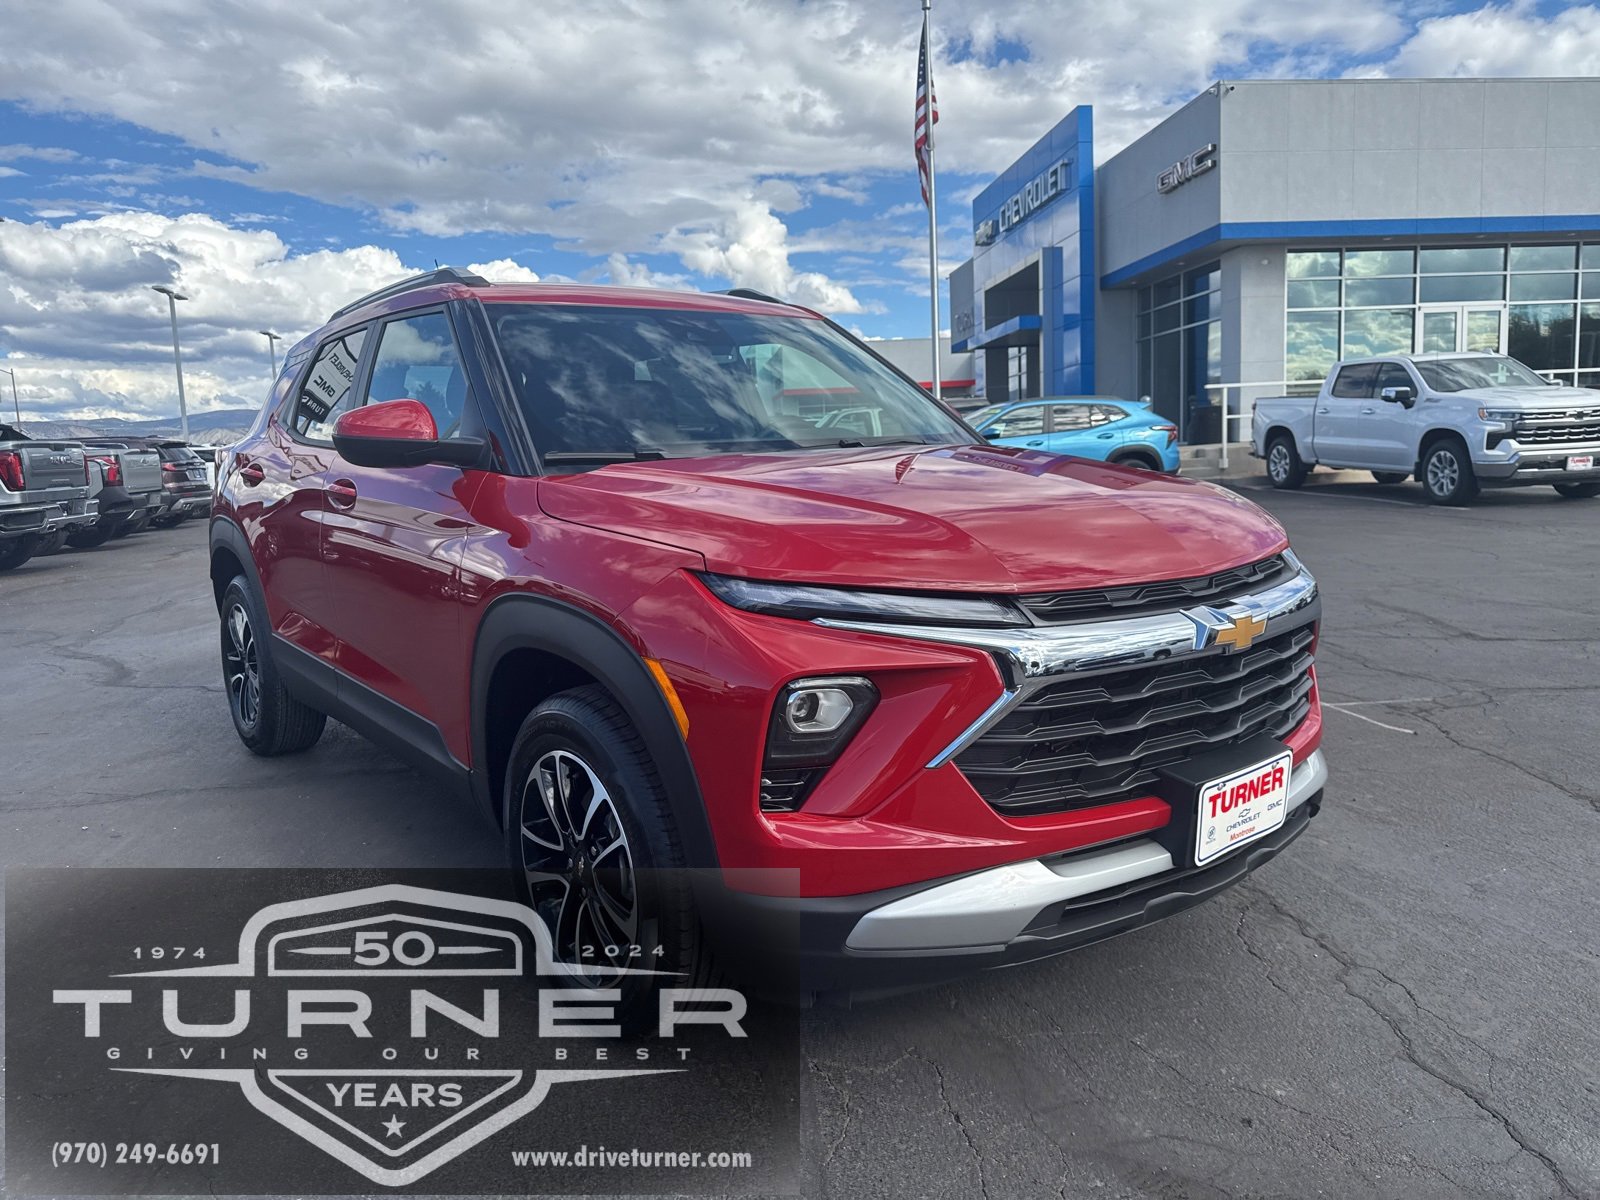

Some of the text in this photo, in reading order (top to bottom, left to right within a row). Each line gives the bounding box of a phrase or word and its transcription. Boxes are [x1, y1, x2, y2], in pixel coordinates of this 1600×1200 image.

[1156, 143, 1217, 194] GMC
[999, 159, 1069, 233] CHEVROLET
[1208, 767, 1284, 818] TURNER
[1267, 799, 1283, 811] GMC
[1226, 812, 1261, 832] CHEVROLET
[1229, 826, 1256, 841] Montrose
